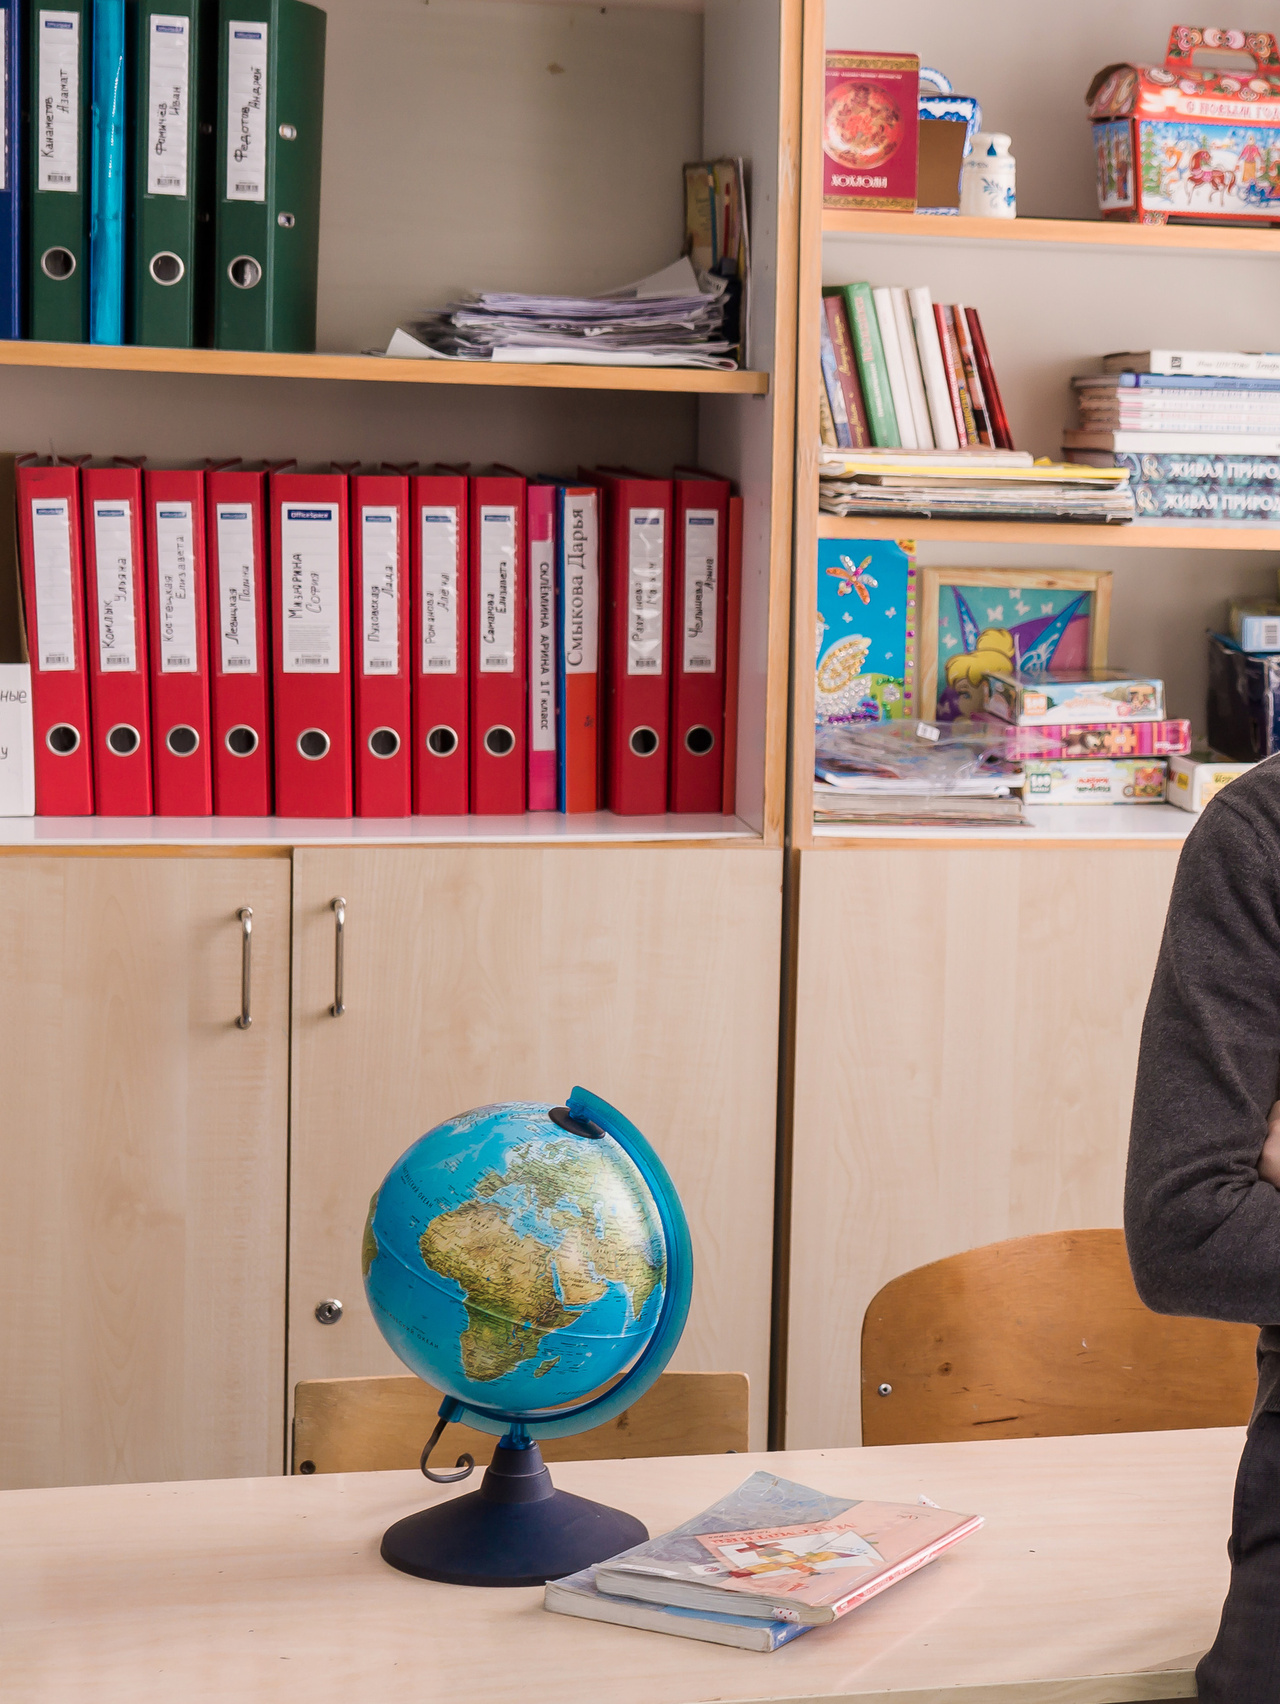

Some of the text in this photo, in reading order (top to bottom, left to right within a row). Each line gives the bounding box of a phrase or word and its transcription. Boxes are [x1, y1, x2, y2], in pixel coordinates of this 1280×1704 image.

[57, 68, 70, 114] Азамат
[168, 85, 181, 117] Иван
[248, 66, 262, 111] Андрей
[234, 106, 250, 163] Федотов
[1169, 463, 1224, 479] ЖИВАЯ
[1164, 494, 1218, 511] ЖИВАЯ
[175, 535, 187, 600] Елизавета
[567, 508, 588, 667] Смыкова Дарья
[540, 634, 549, 675] АРИНА
